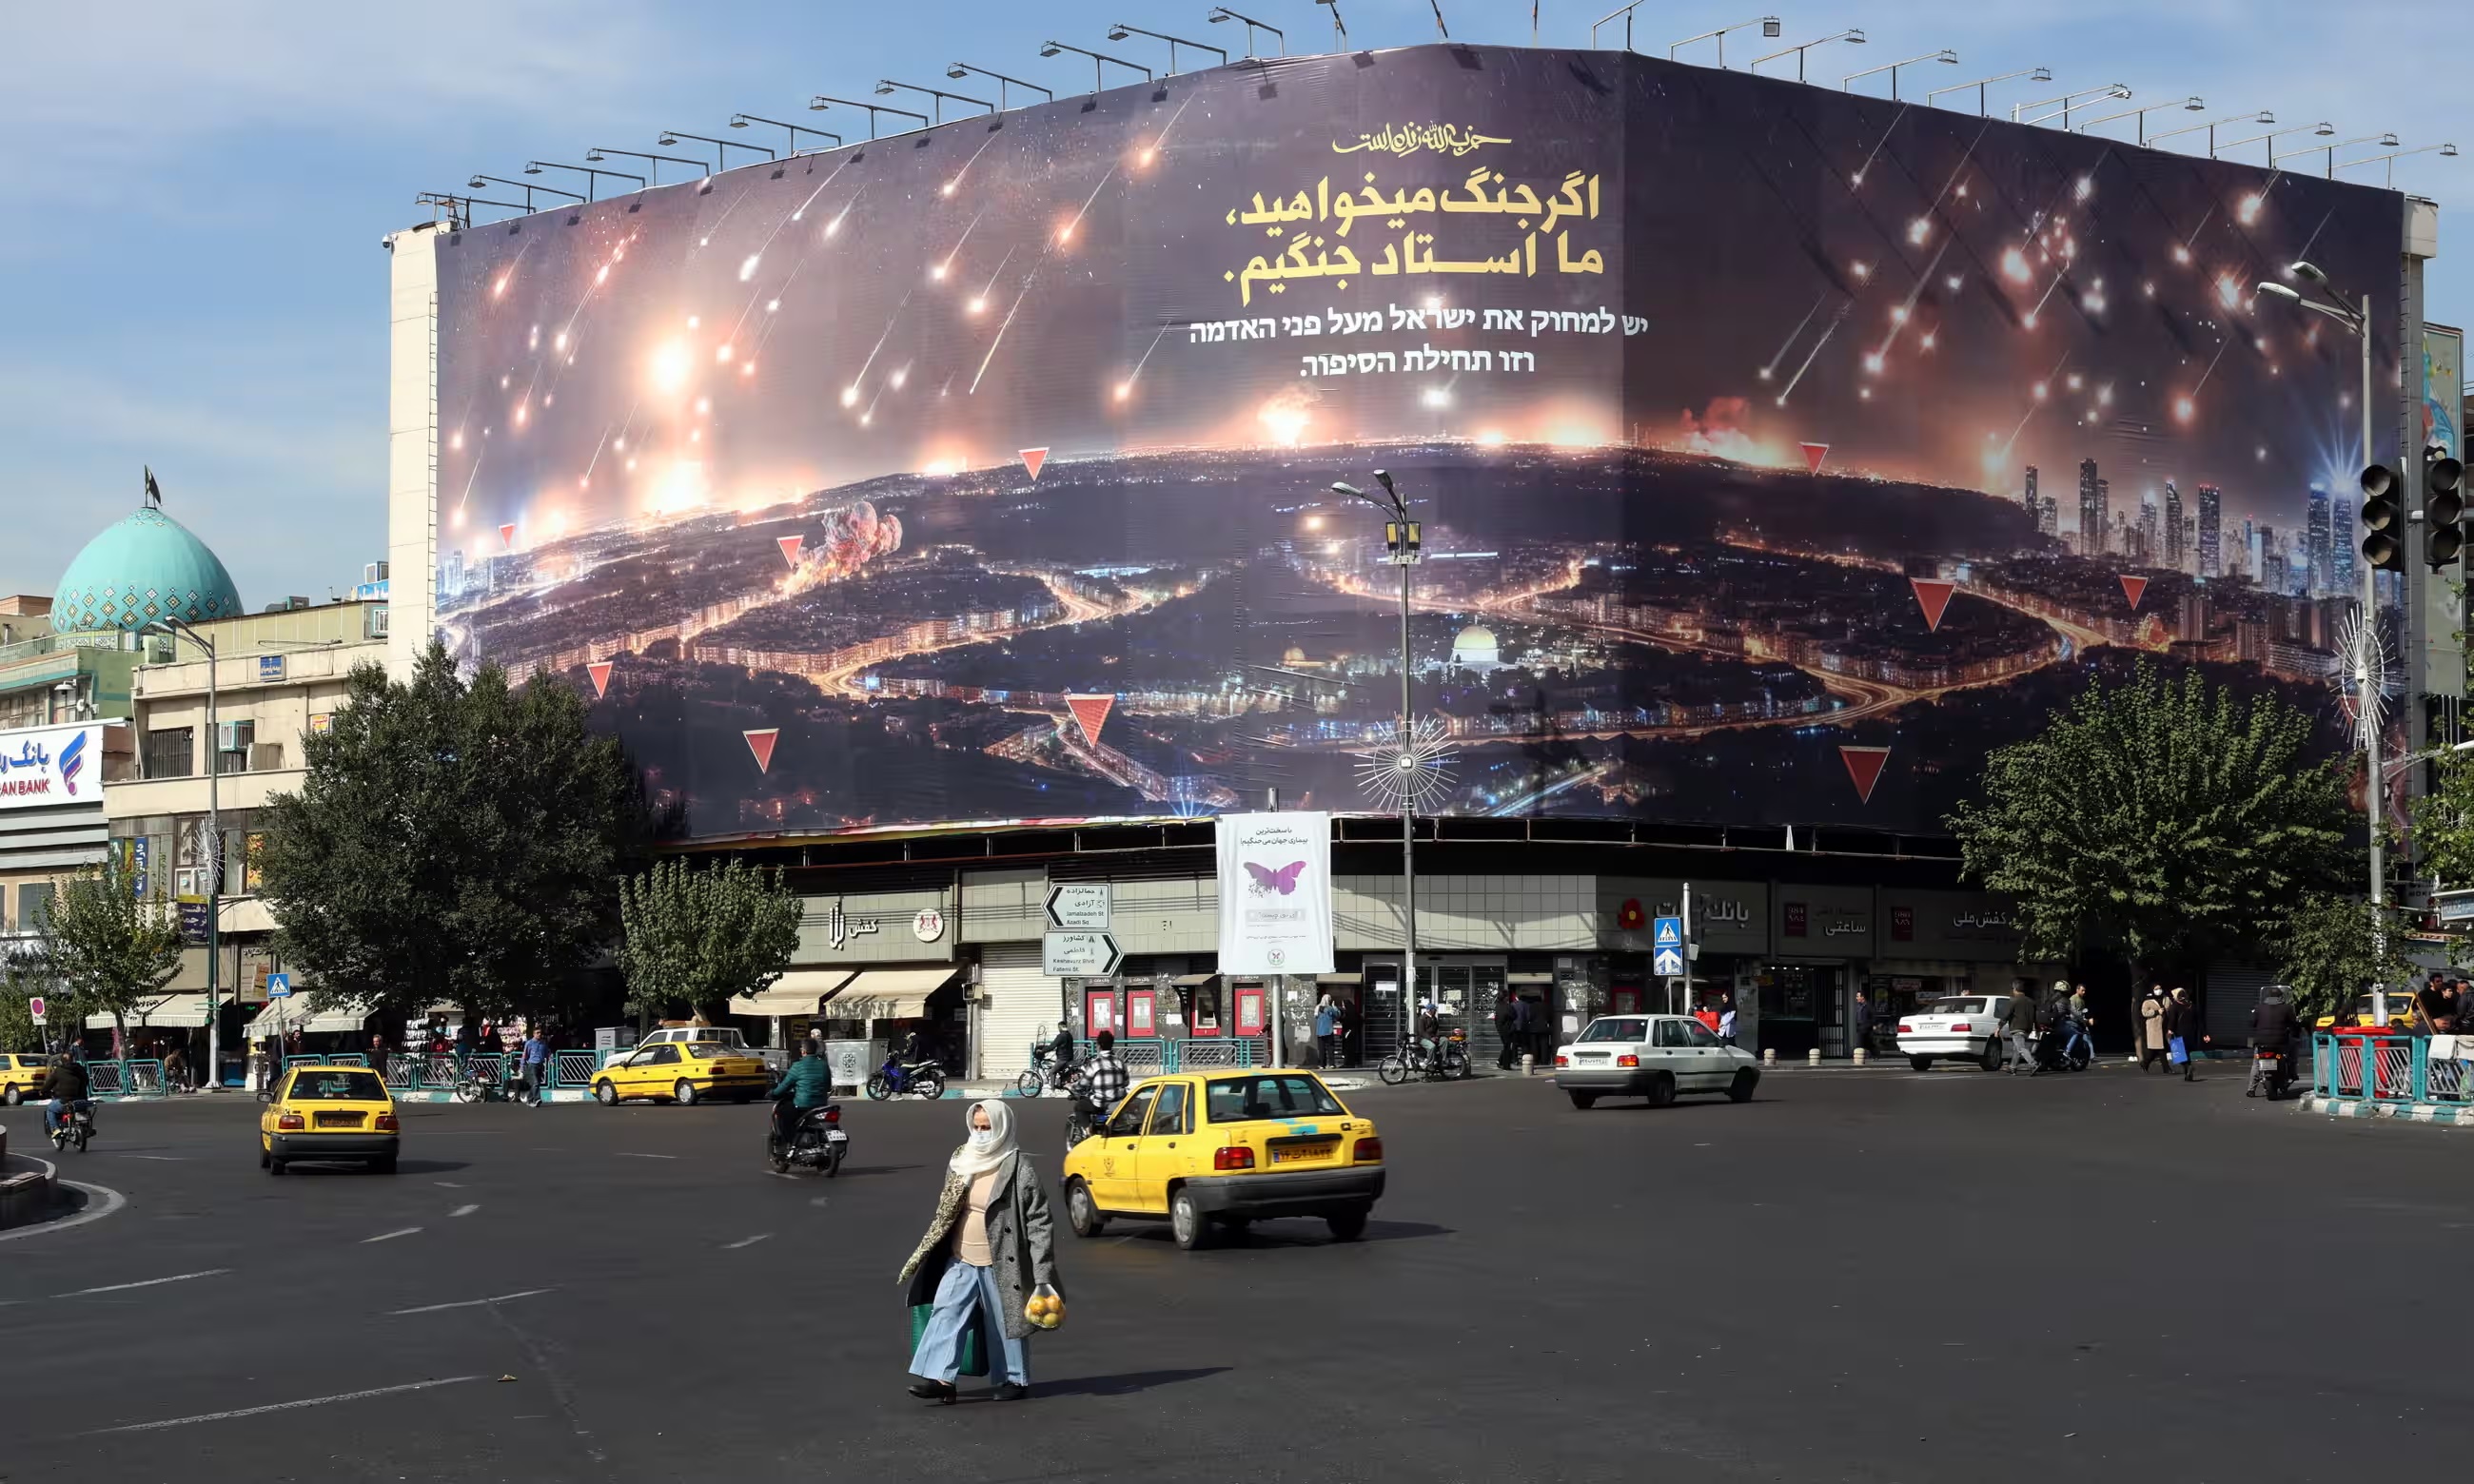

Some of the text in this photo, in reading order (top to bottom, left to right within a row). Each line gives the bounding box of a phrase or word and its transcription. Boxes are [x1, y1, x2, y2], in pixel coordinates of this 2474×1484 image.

[1441, 166, 1541, 230] جنگ
[1541, 169, 1600, 233] اگر
[1224, 230, 1604, 306] ما استاد جنگیم.
[1188, 303, 1648, 342] יש למחוק את ישראל מעל פני האדמה
[1300, 343, 1535, 377] וזו תחילת הסיפור.
[10, 739, 50, 773] بانک
[19, 778, 50, 795] BANK
[849, 918, 877, 937] کفش
[1825, 920, 1866, 936] ساعتی
[1954, 910, 2007, 928] کفش ملی
